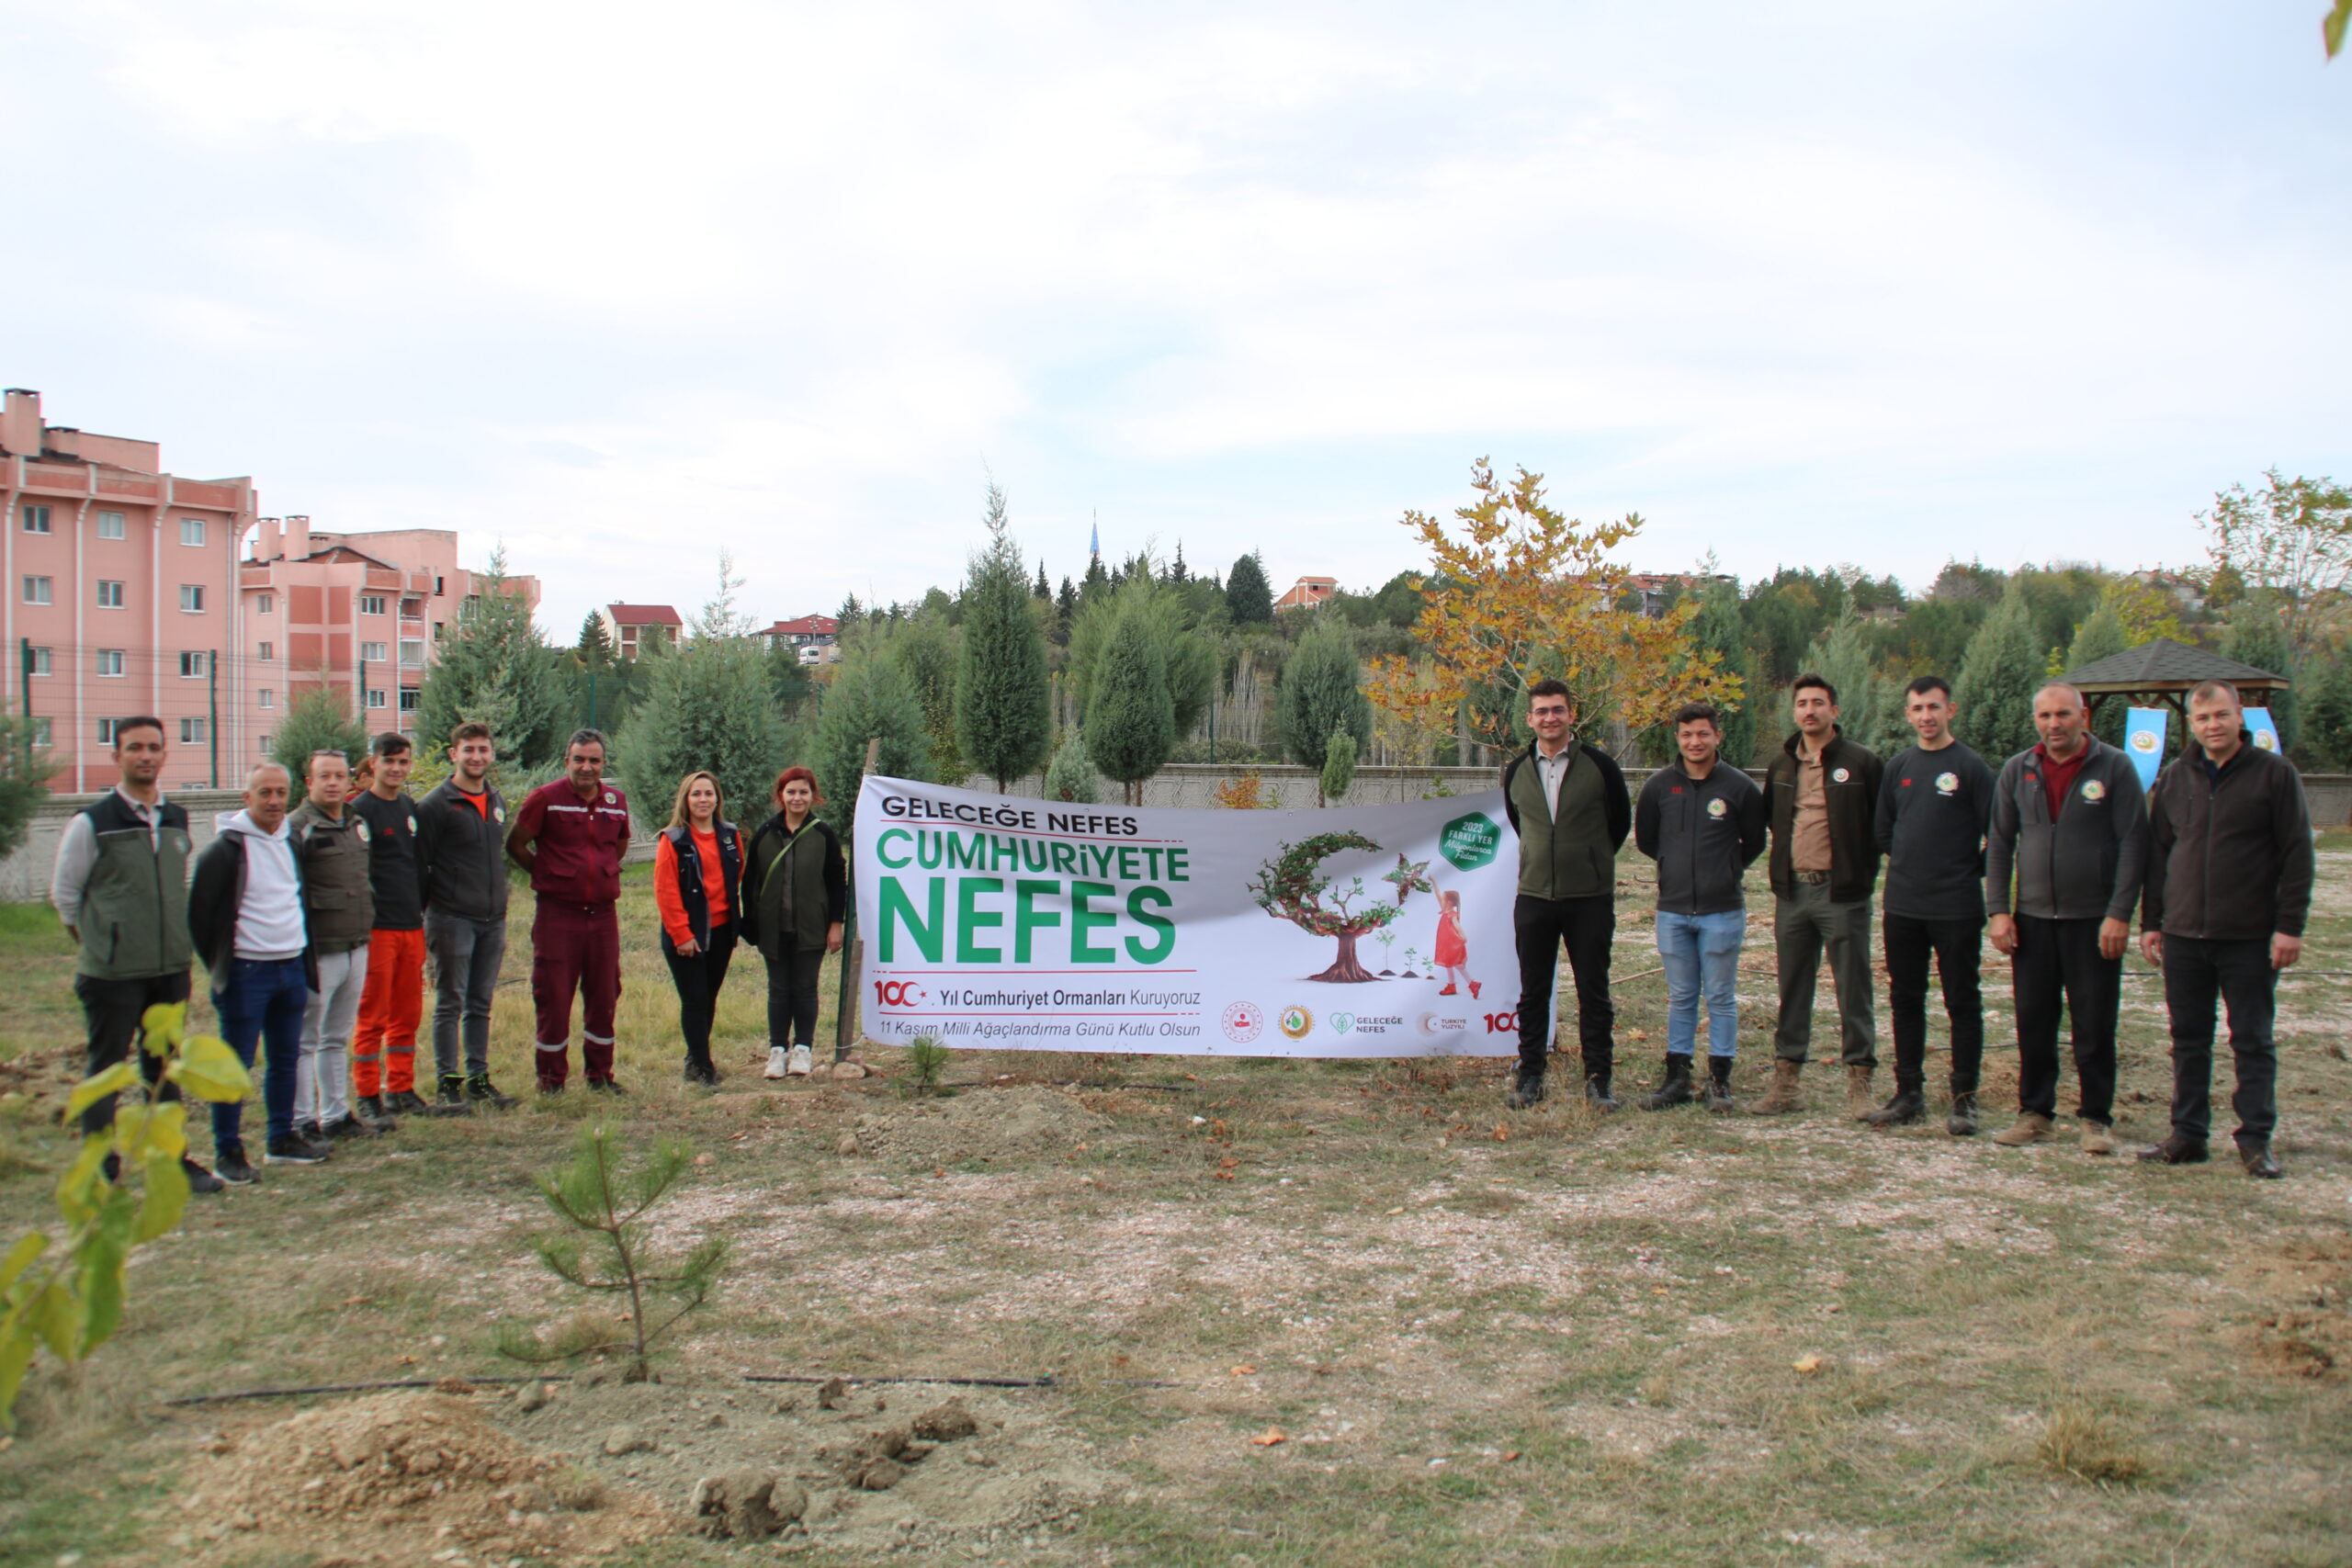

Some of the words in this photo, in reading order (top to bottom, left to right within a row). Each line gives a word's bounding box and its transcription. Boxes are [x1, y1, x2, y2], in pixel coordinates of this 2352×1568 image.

[881, 795, 1036, 830] GELECEĞE
[1047, 813, 1138, 836] NEFES
[1462, 821, 1484, 833] 2023
[1448, 829, 1476, 842] FARKLI
[1478, 834, 1493, 845] YER
[878, 875, 1176, 964] NEFES
[940, 989, 958, 1006] Yıl
[963, 989, 1048, 1010] Cumhuriyet
[1053, 988, 1125, 1006] Ormanları
[1130, 988, 1201, 1010] Kuruyoruz
[1356, 1015, 1403, 1025] GELECEĞE
[879, 1021, 891, 1034] 11
[895, 1021, 938, 1035] Kasım
[942, 1021, 970, 1035] Milli
[973, 1021, 1070, 1039] Ağaçlandırma
[1075, 1021, 1114, 1036] Günü
[1118, 1022, 1155, 1037] Kutlu
[1159, 1021, 1201, 1036] Olsun
[1356, 1025, 1385, 1033] NEFES
